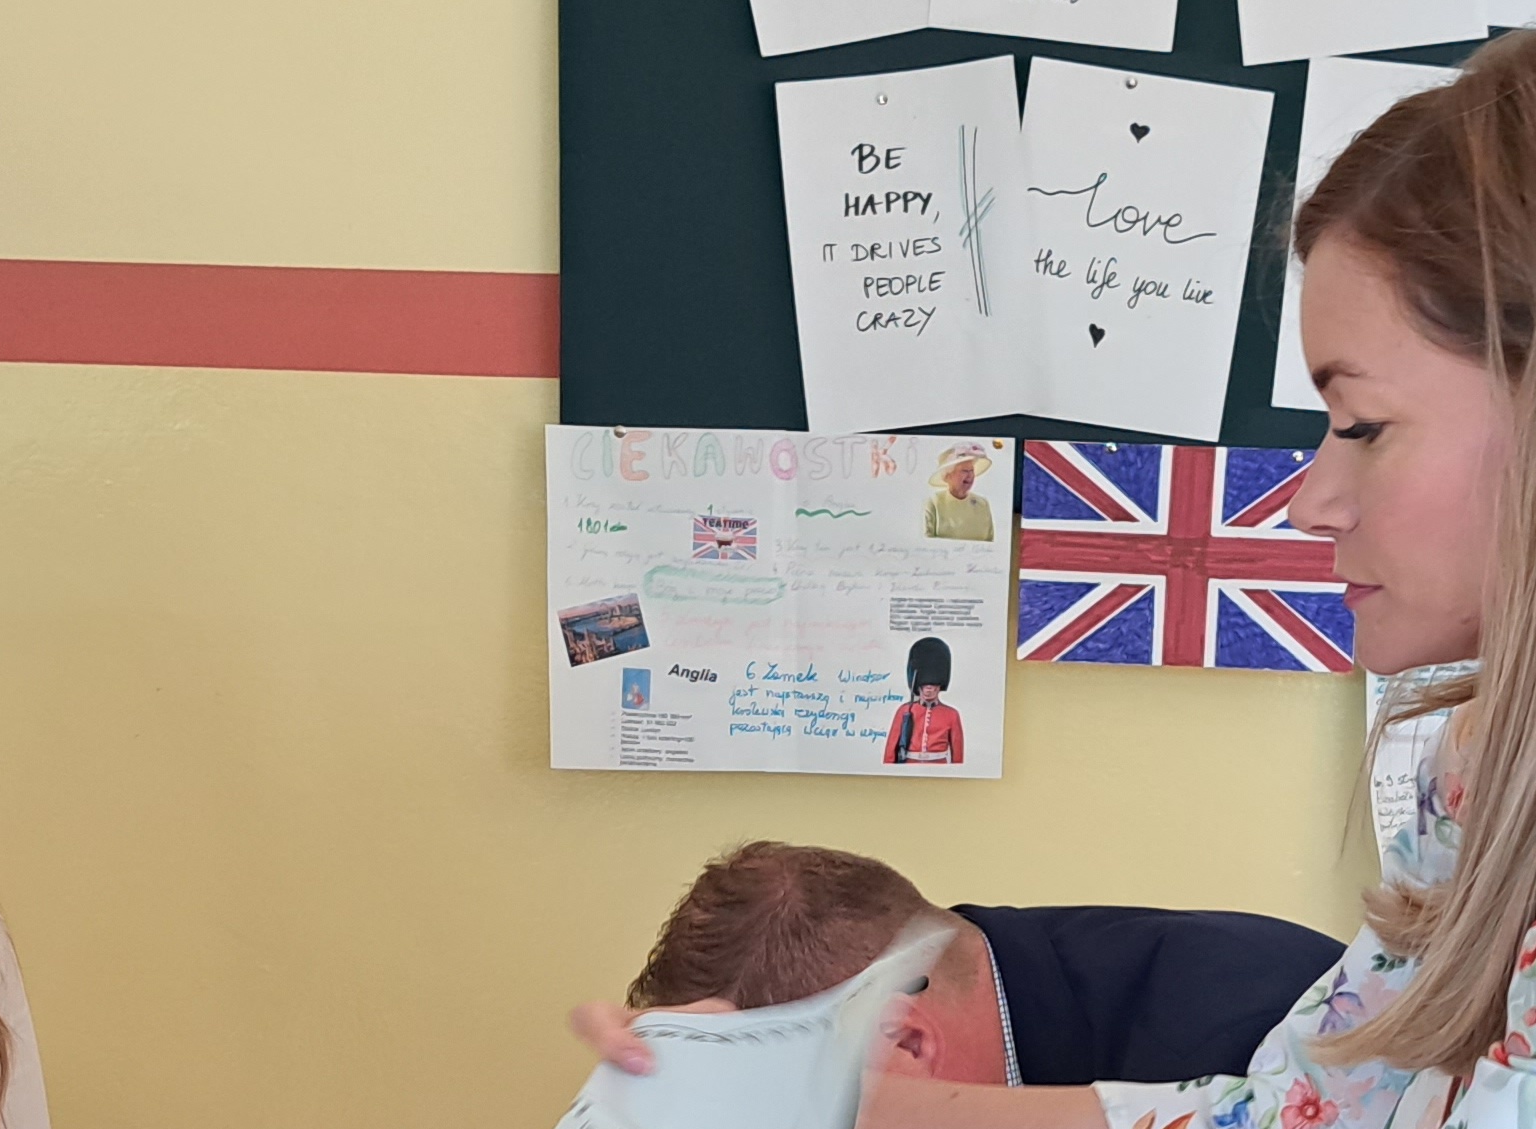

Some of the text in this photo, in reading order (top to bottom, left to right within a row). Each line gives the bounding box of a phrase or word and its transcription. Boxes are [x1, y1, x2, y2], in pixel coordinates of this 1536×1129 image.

[852, 142, 904, 174] BE
[843, 192, 941, 224] HAPPY,
[822, 236, 943, 263] IT DRIVES
[863, 271, 946, 298] PEOPLE
[1034, 250, 1214, 310] the life you live
[855, 306, 937, 337] CRAZY
[668, 663, 718, 683] Anglia
